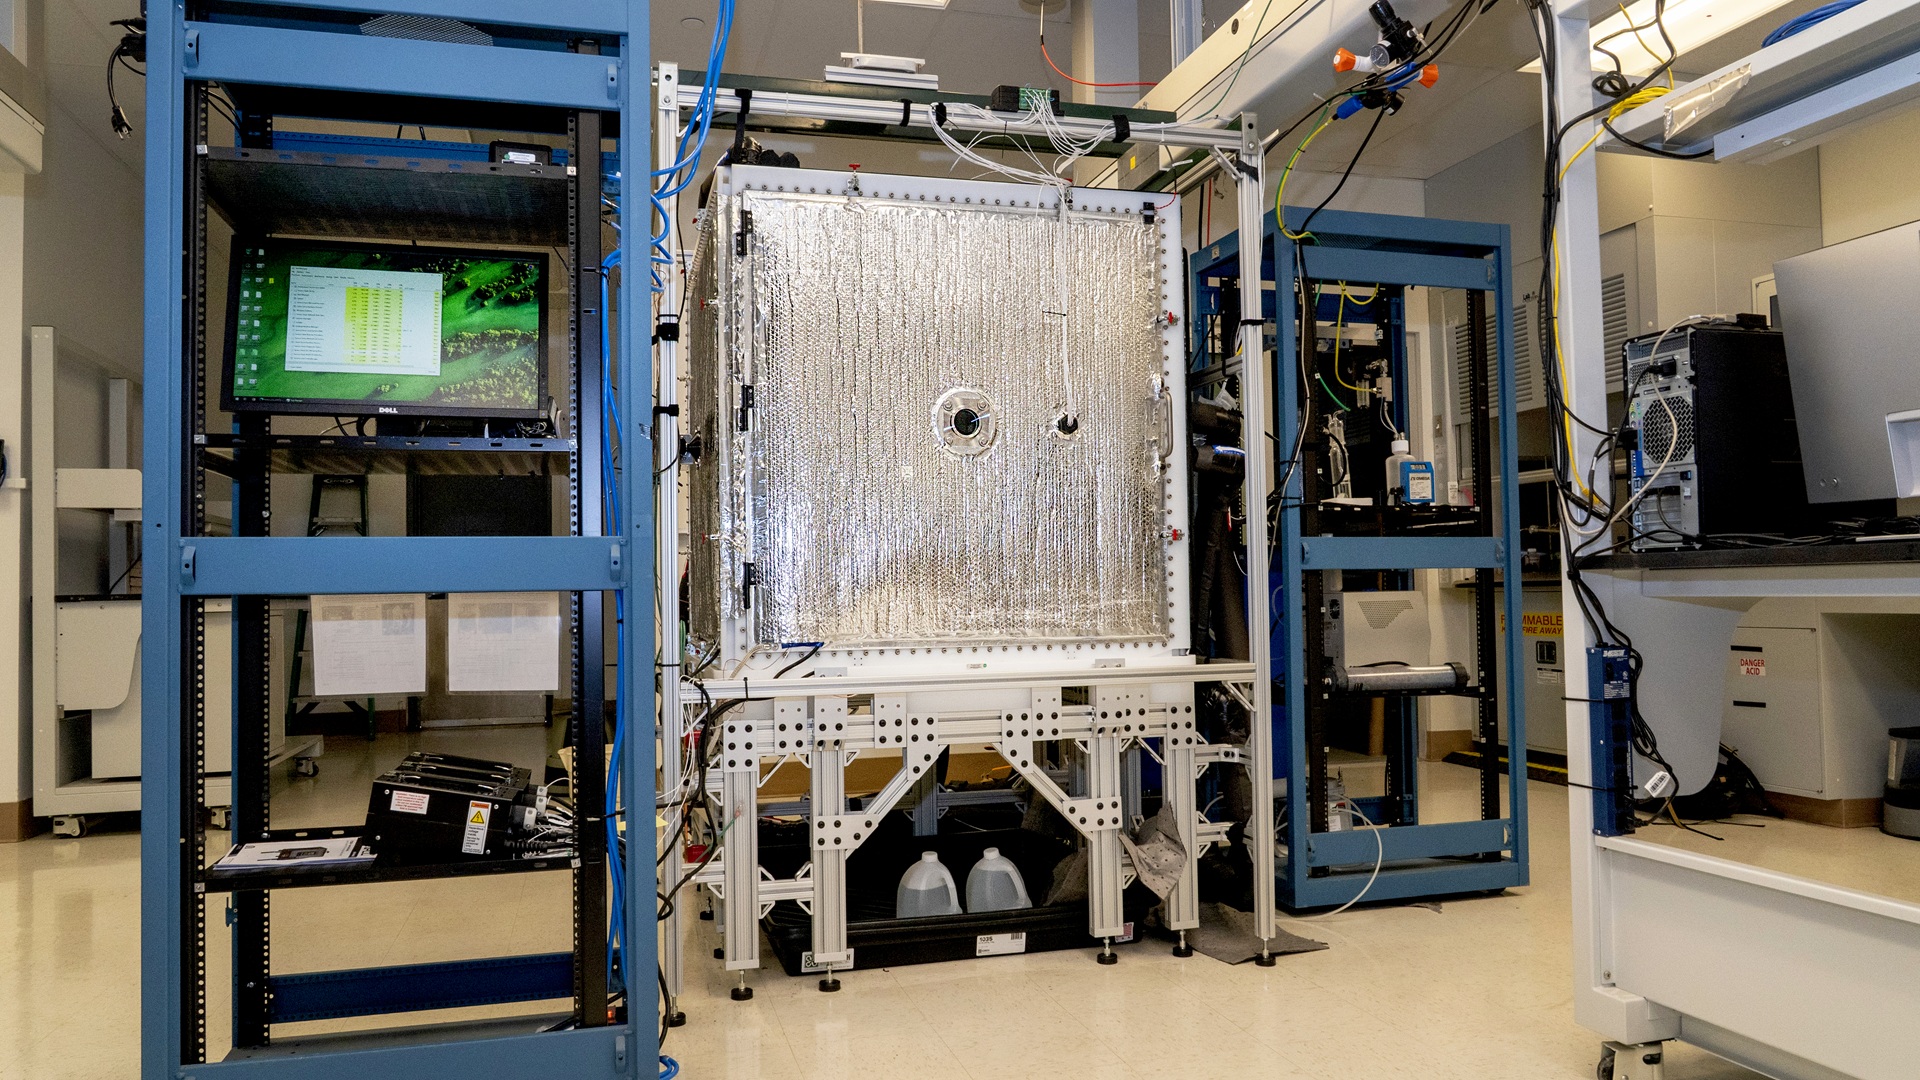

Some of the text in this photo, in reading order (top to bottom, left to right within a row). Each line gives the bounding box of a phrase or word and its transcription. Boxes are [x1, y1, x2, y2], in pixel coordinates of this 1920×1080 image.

[1522, 626, 1562, 635] FIRE AWAY
[1740, 658, 1765, 667] DANGER
[1745, 667, 1760, 676] ACID
